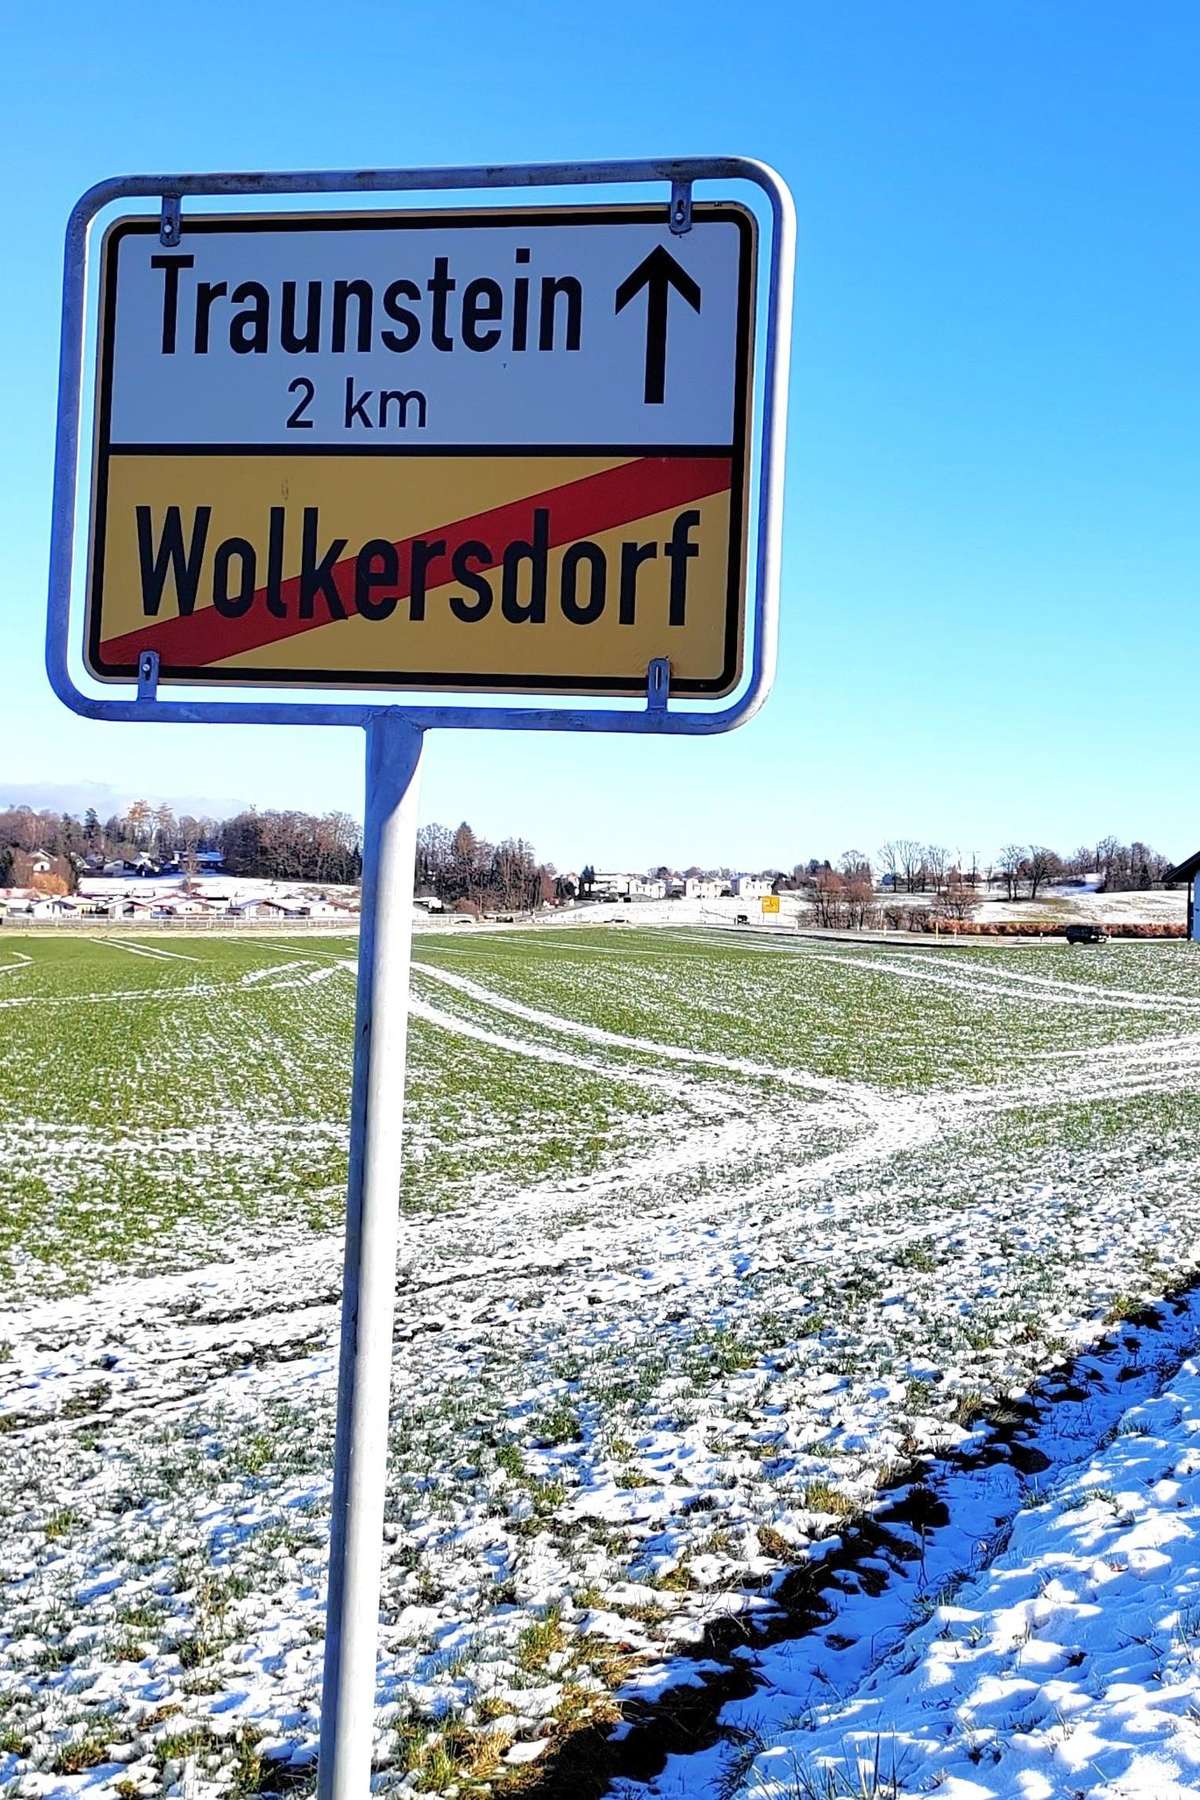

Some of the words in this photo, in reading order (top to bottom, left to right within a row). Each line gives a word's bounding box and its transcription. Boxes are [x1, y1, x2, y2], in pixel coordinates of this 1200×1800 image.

[150, 247, 583, 355] Traunstein
[286, 377, 315, 429] 2
[343, 376, 428, 429] km
[135, 505, 701, 627] Wolkersdorf
